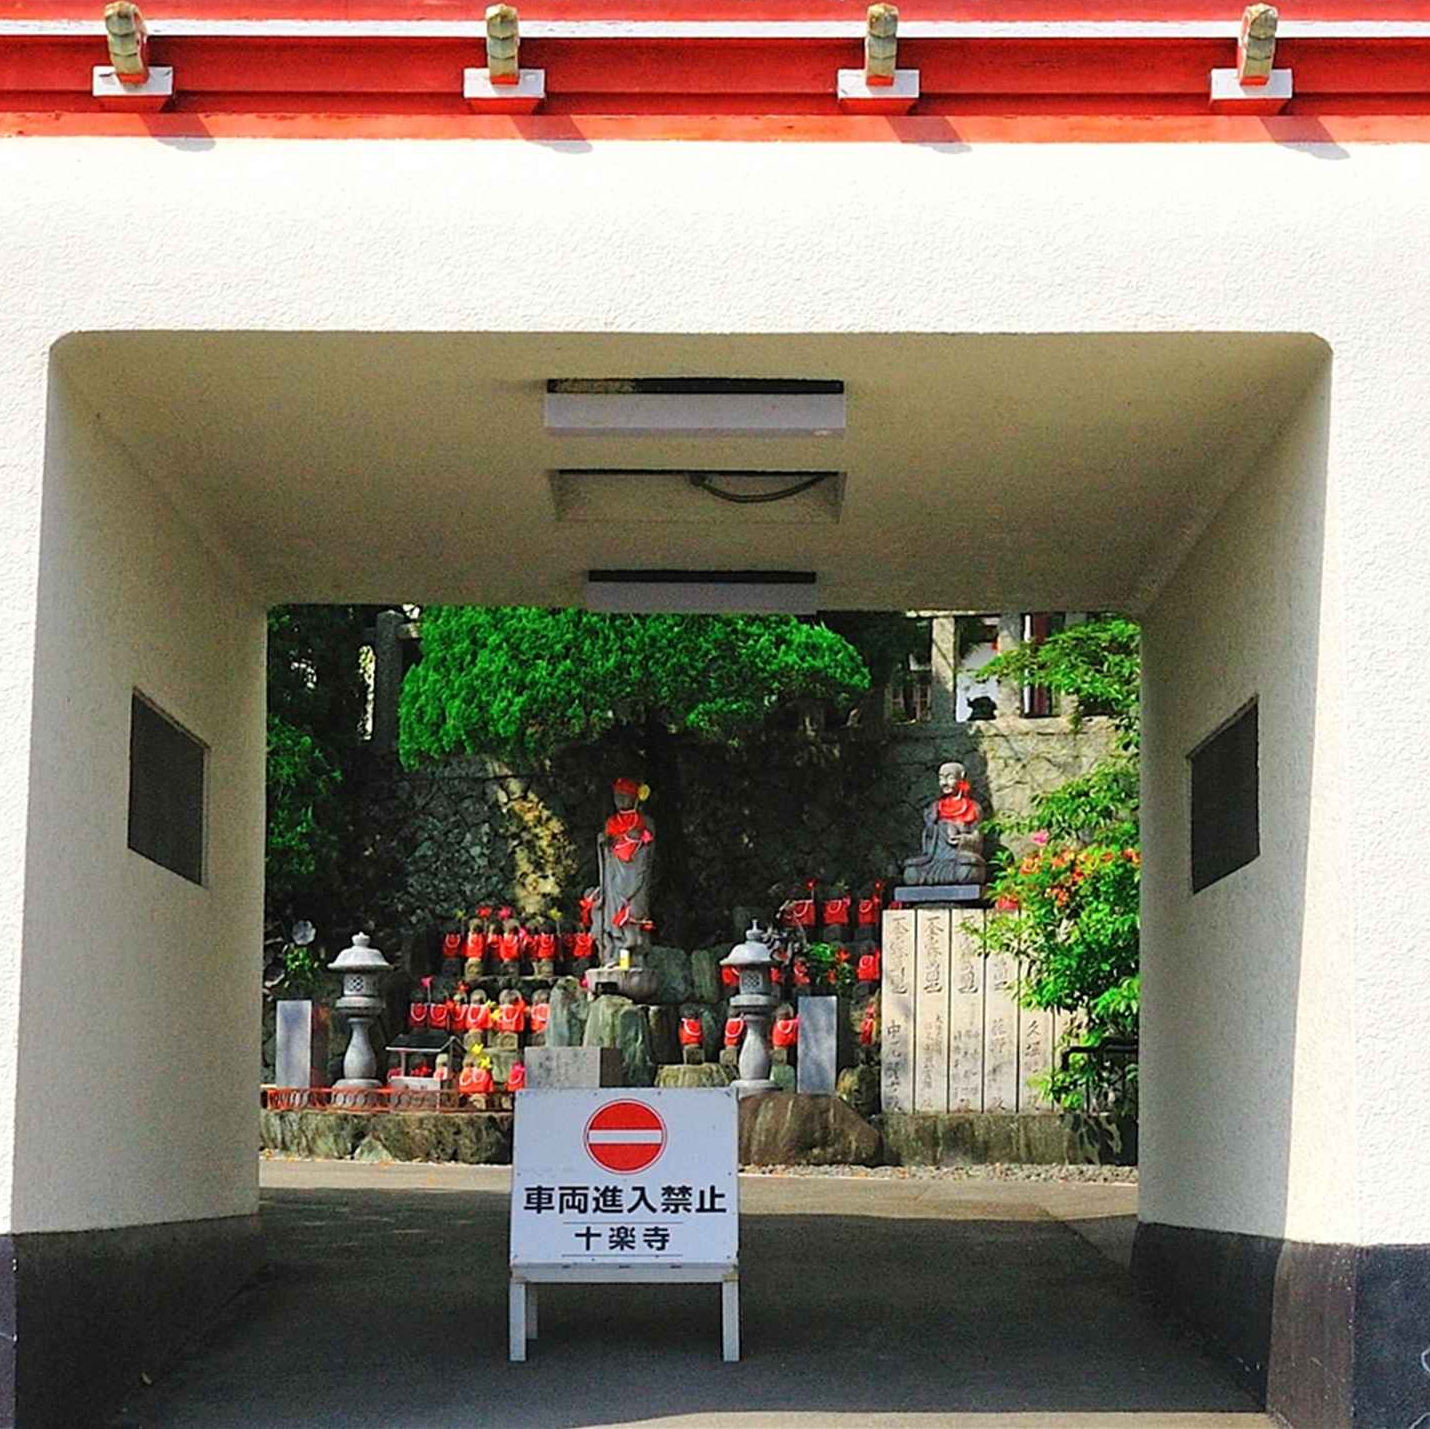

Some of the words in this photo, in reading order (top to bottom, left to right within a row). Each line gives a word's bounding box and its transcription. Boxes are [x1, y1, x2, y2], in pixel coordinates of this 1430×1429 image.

[523, 1185, 728, 1214] 車両進入禁止
[574, 1226, 671, 1252] 十楽寺
